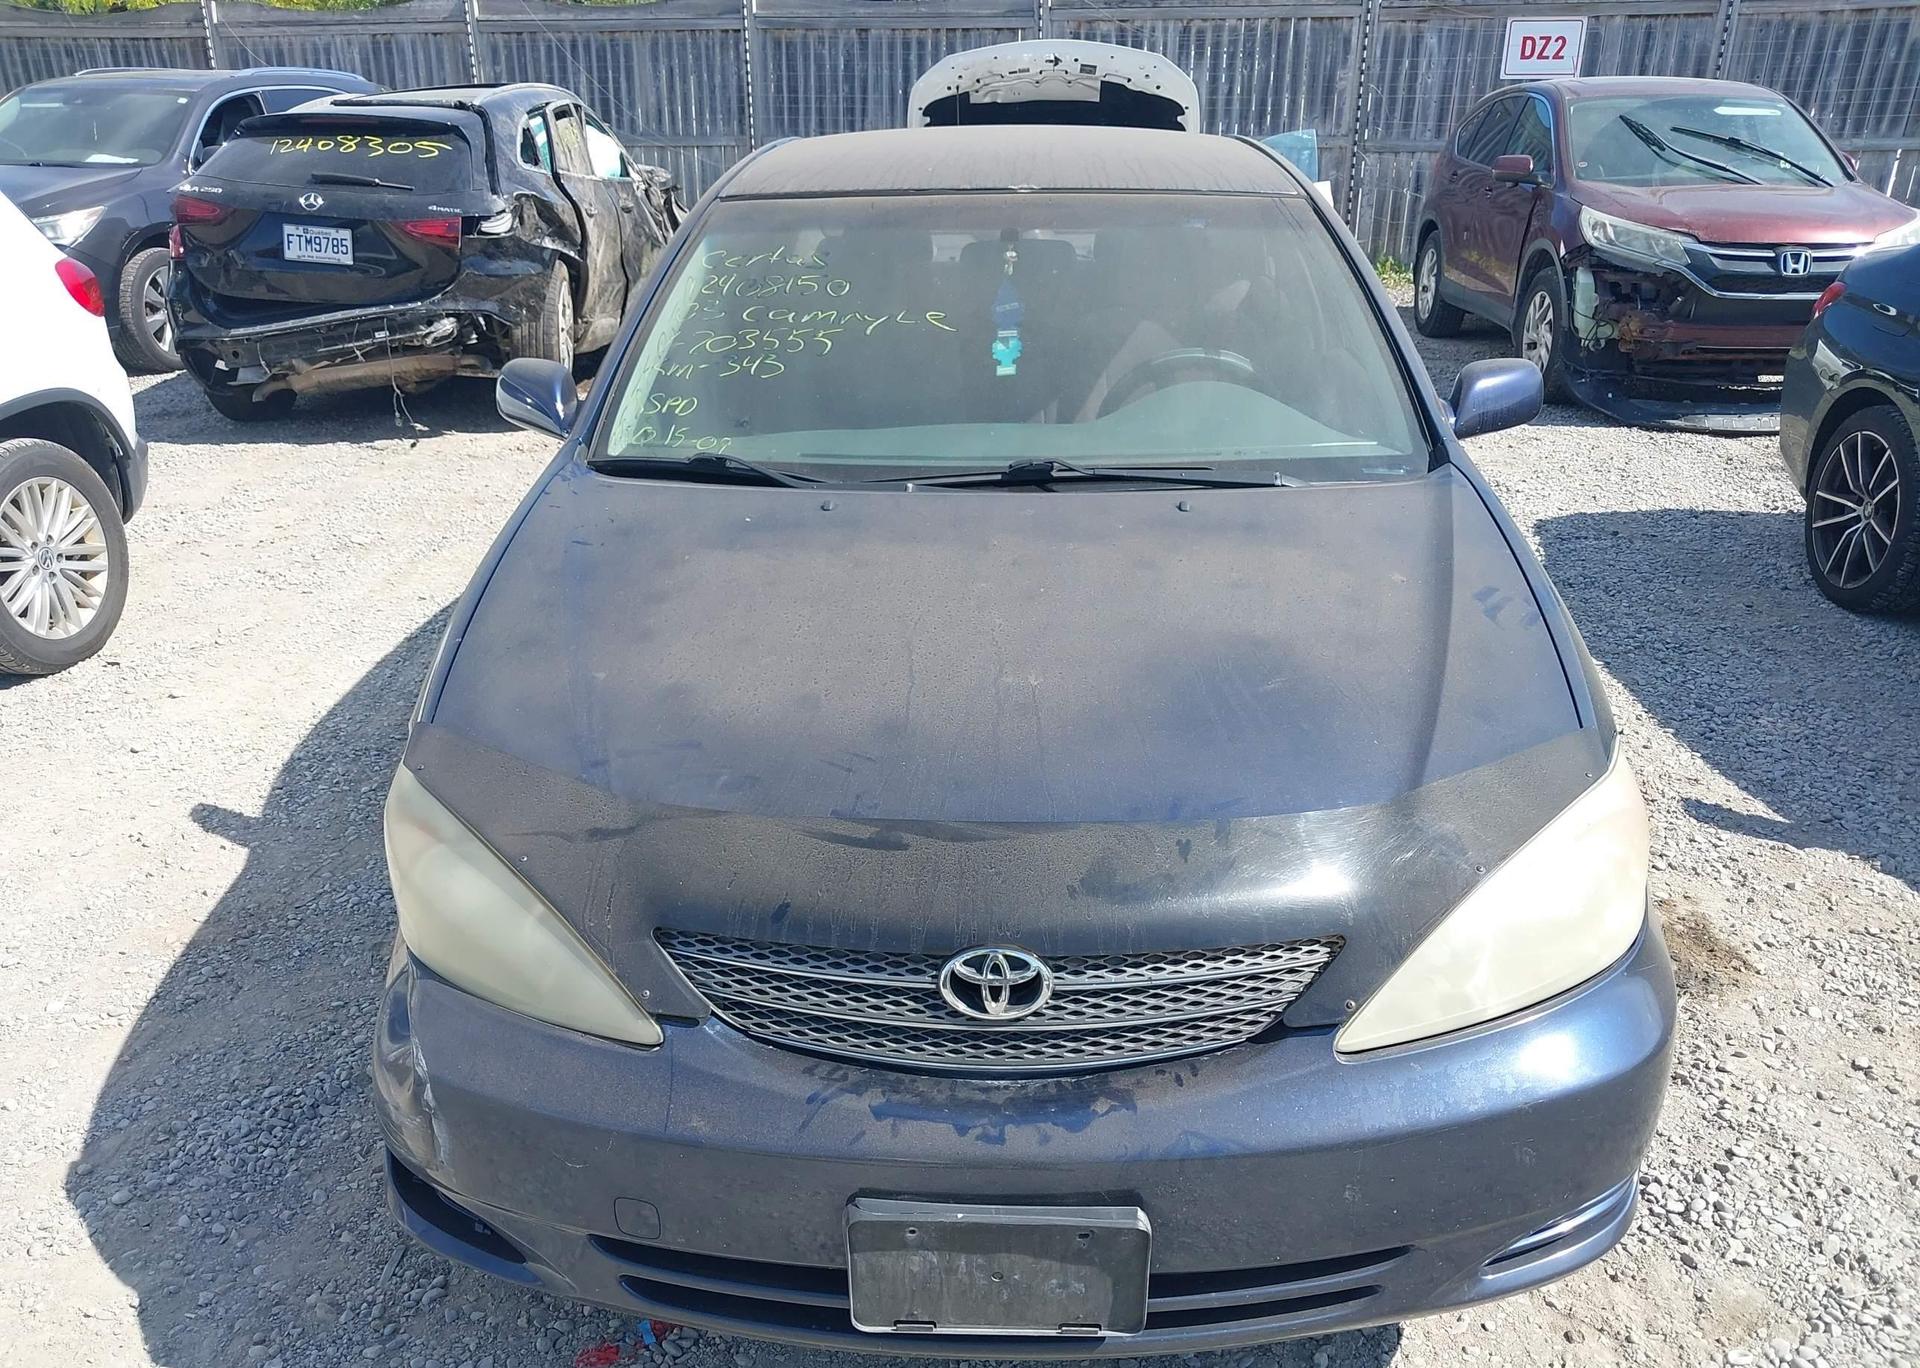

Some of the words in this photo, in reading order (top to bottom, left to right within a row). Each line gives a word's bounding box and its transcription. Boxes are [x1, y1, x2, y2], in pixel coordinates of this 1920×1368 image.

[1520, 35, 1567, 60] DZ2
[270, 135, 453, 158] 12408305
[286, 233, 349, 255] FTM9785
